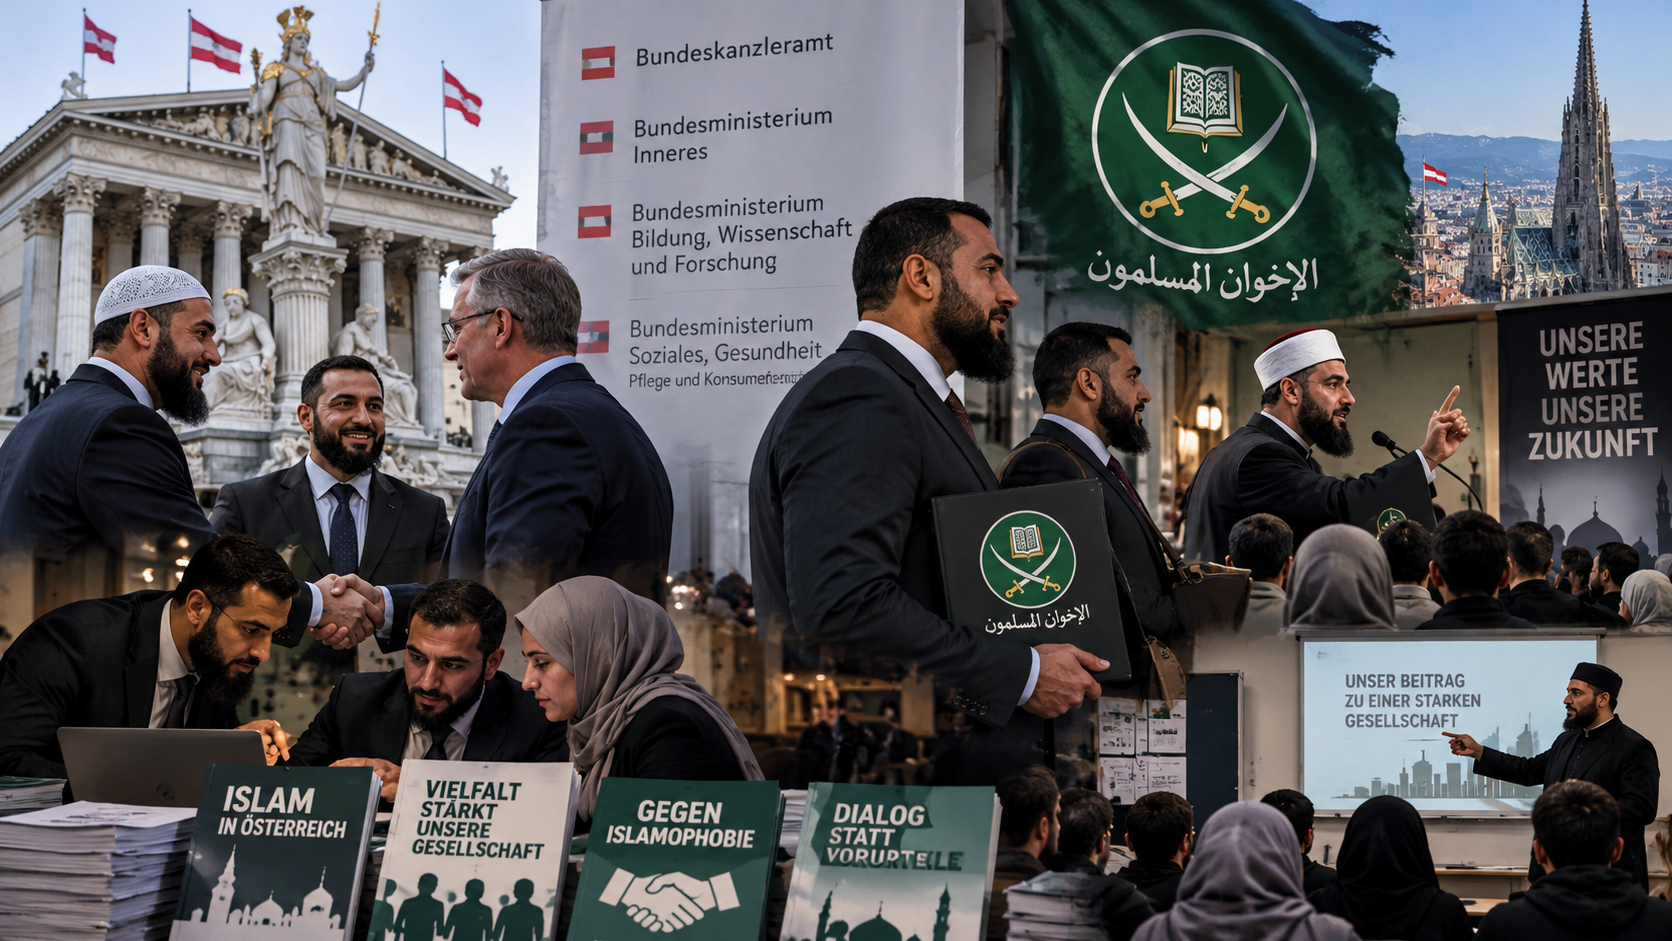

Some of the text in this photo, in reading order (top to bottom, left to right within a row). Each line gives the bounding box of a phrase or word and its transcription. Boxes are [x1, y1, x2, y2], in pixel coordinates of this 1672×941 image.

[635, 33, 834, 67] Bundeskanzleramt
[634, 107, 833, 138] Bundesministerium
[633, 144, 708, 164] Inneres
[632, 195, 824, 222] Bundesministerium
[631, 217, 853, 250] Bildung, Wissenschaft
[631, 251, 777, 275] und Forschung
[1087, 249, 1319, 303] الإخوان المسلمون
[630, 314, 814, 338] Bundesministerium
[1539, 320, 1644, 357] UNSERE
[629, 340, 823, 366] Soziales, Gesundheit
[629, 373, 671, 391] Pflege
[675, 372, 700, 387] und
[1545, 356, 1639, 390] WERTE
[1541, 392, 1644, 426] UNSERE
[1528, 427, 1659, 461] ZUKUNFT
[984, 603, 1091, 635] الإخوان المسلمون
[1345, 673, 1466, 688] UNSER BEITRAG
[1344, 693, 1482, 708] ZU EINER STARKEN
[1344, 713, 1459, 728] GESELLSCHAFT
[223, 785, 315, 814] ISLAM
[426, 779, 522, 801] VIELFALT
[420, 799, 498, 820] STÄRKT
[637, 800, 723, 825] GEGEN
[833, 802, 926, 827] DIALOG
[217, 814, 347, 839] IN ÖSTERREICH
[416, 820, 492, 838] UNSERE
[606, 825, 756, 849] ISLAMOPHOBIE
[828, 826, 896, 847] STATT
[411, 838, 545, 860] GESELLSCHAFT
